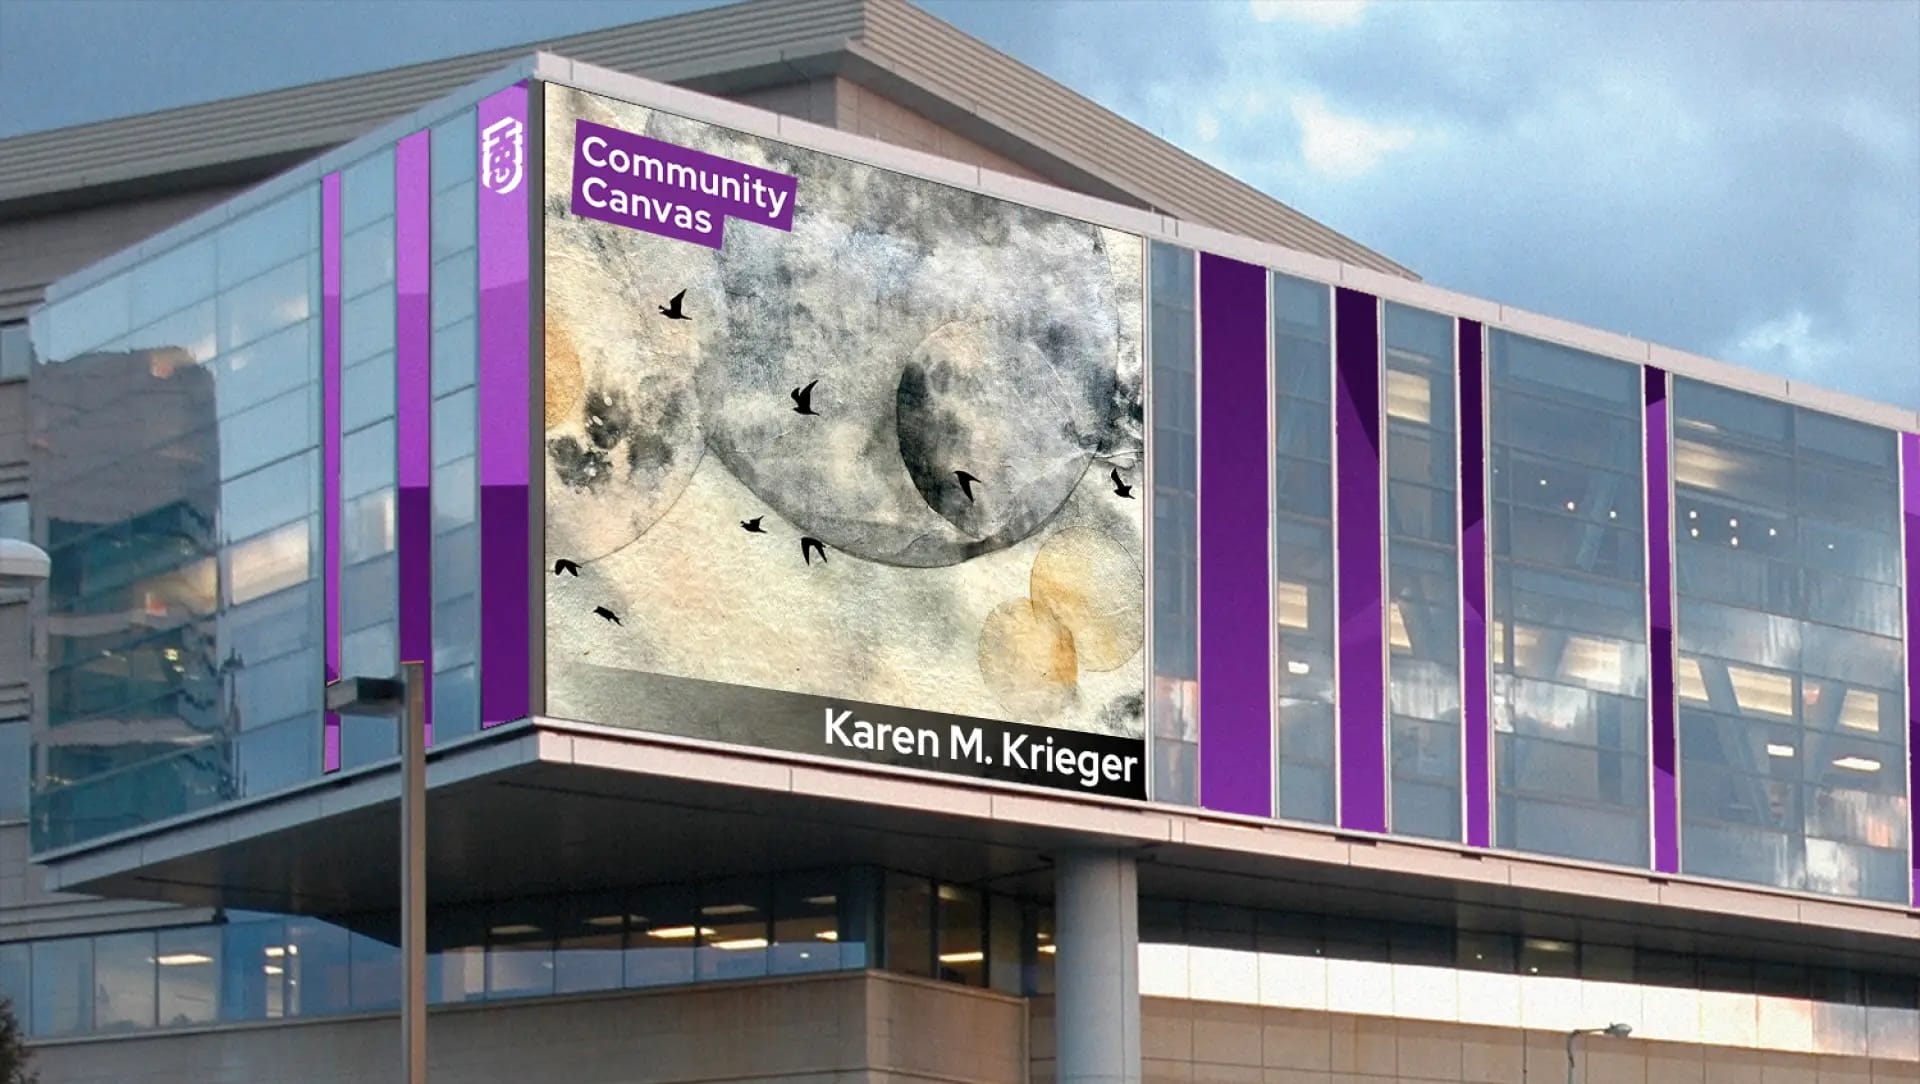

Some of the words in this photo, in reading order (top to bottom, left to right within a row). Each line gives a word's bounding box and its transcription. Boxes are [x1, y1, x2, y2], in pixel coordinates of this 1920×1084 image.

[581, 135, 788, 218] Community
[581, 177, 713, 234] Canvas
[824, 707, 940, 758] Karen
[950, 724, 993, 766] M.
[1002, 731, 1138, 788] Krieger
